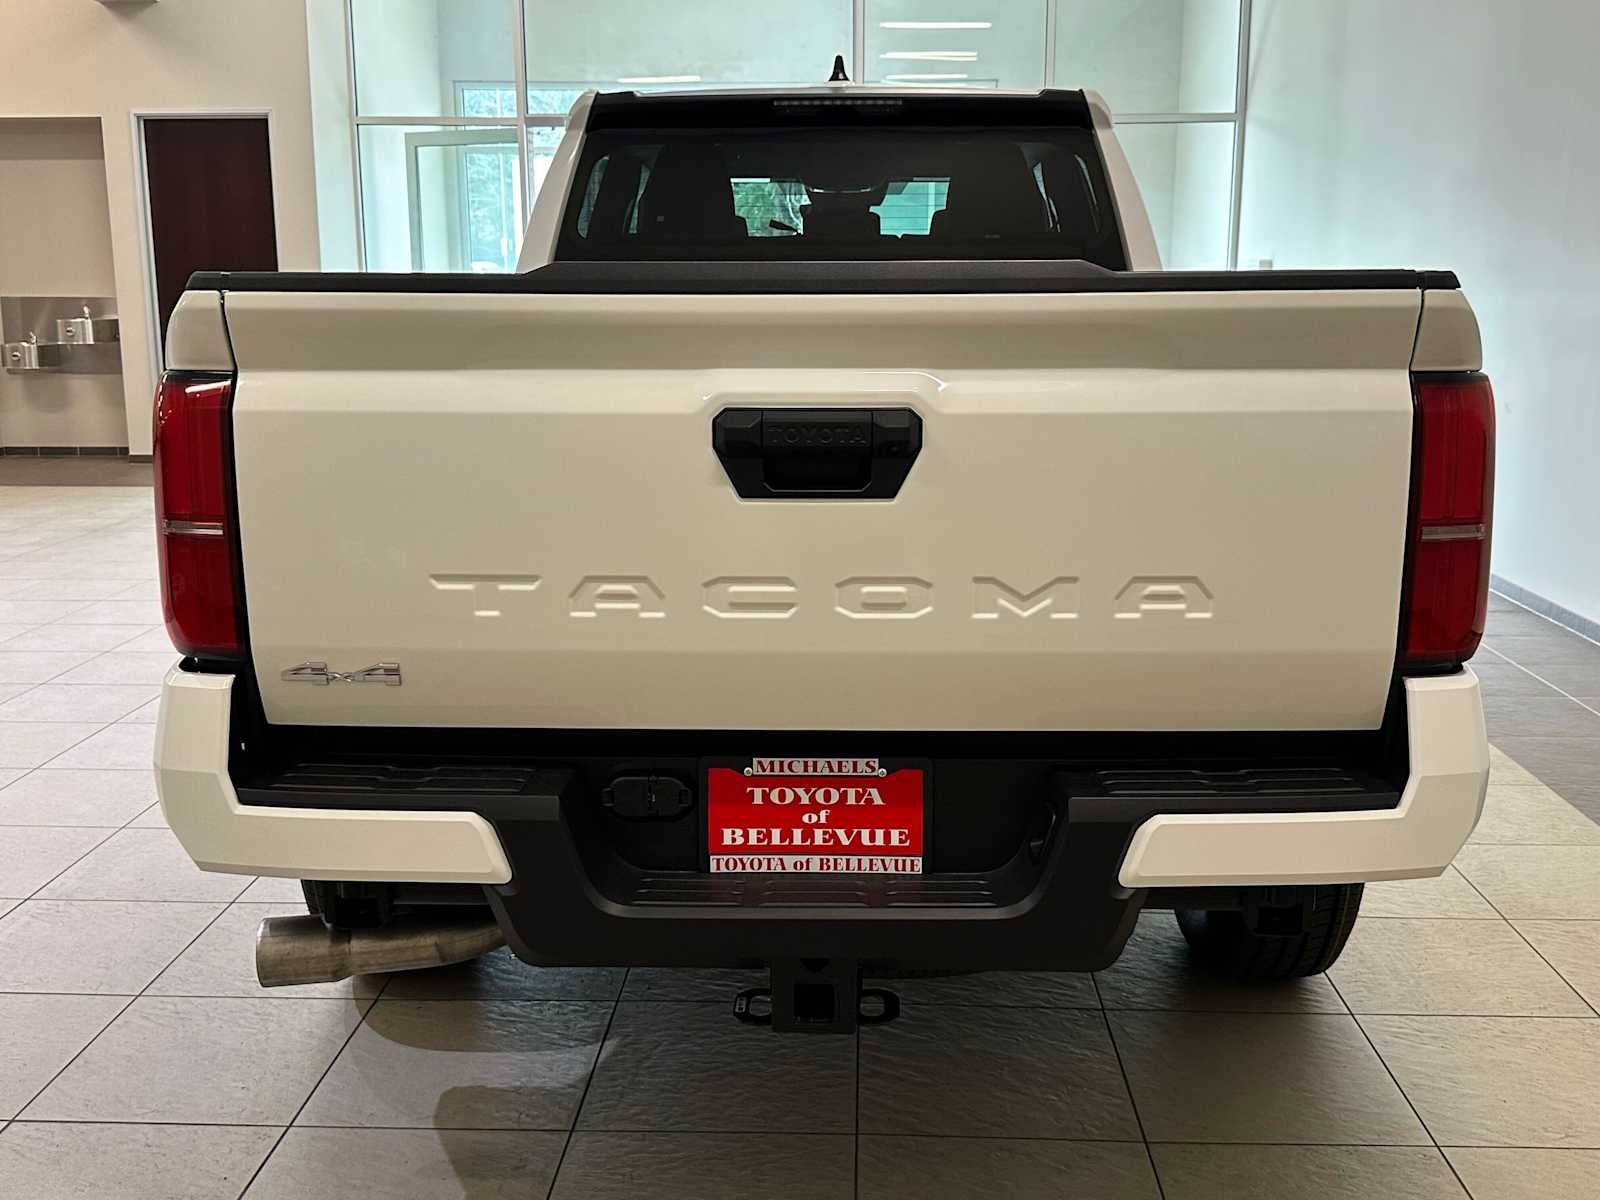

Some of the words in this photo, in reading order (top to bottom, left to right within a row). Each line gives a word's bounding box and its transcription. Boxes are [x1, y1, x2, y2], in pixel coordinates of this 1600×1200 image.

[767, 425, 867, 445] TOYOTA
[429, 573, 1214, 619] TACOMA
[756, 760, 876, 774] MICHAELS
[746, 787, 886, 805] TOYOTA
[801, 809, 831, 824] of
[721, 828, 910, 847] BELLEVUE
[711, 857, 787, 872] TOYOTA
[793, 857, 813, 872] of
[819, 858, 921, 873] BELLEVUE
